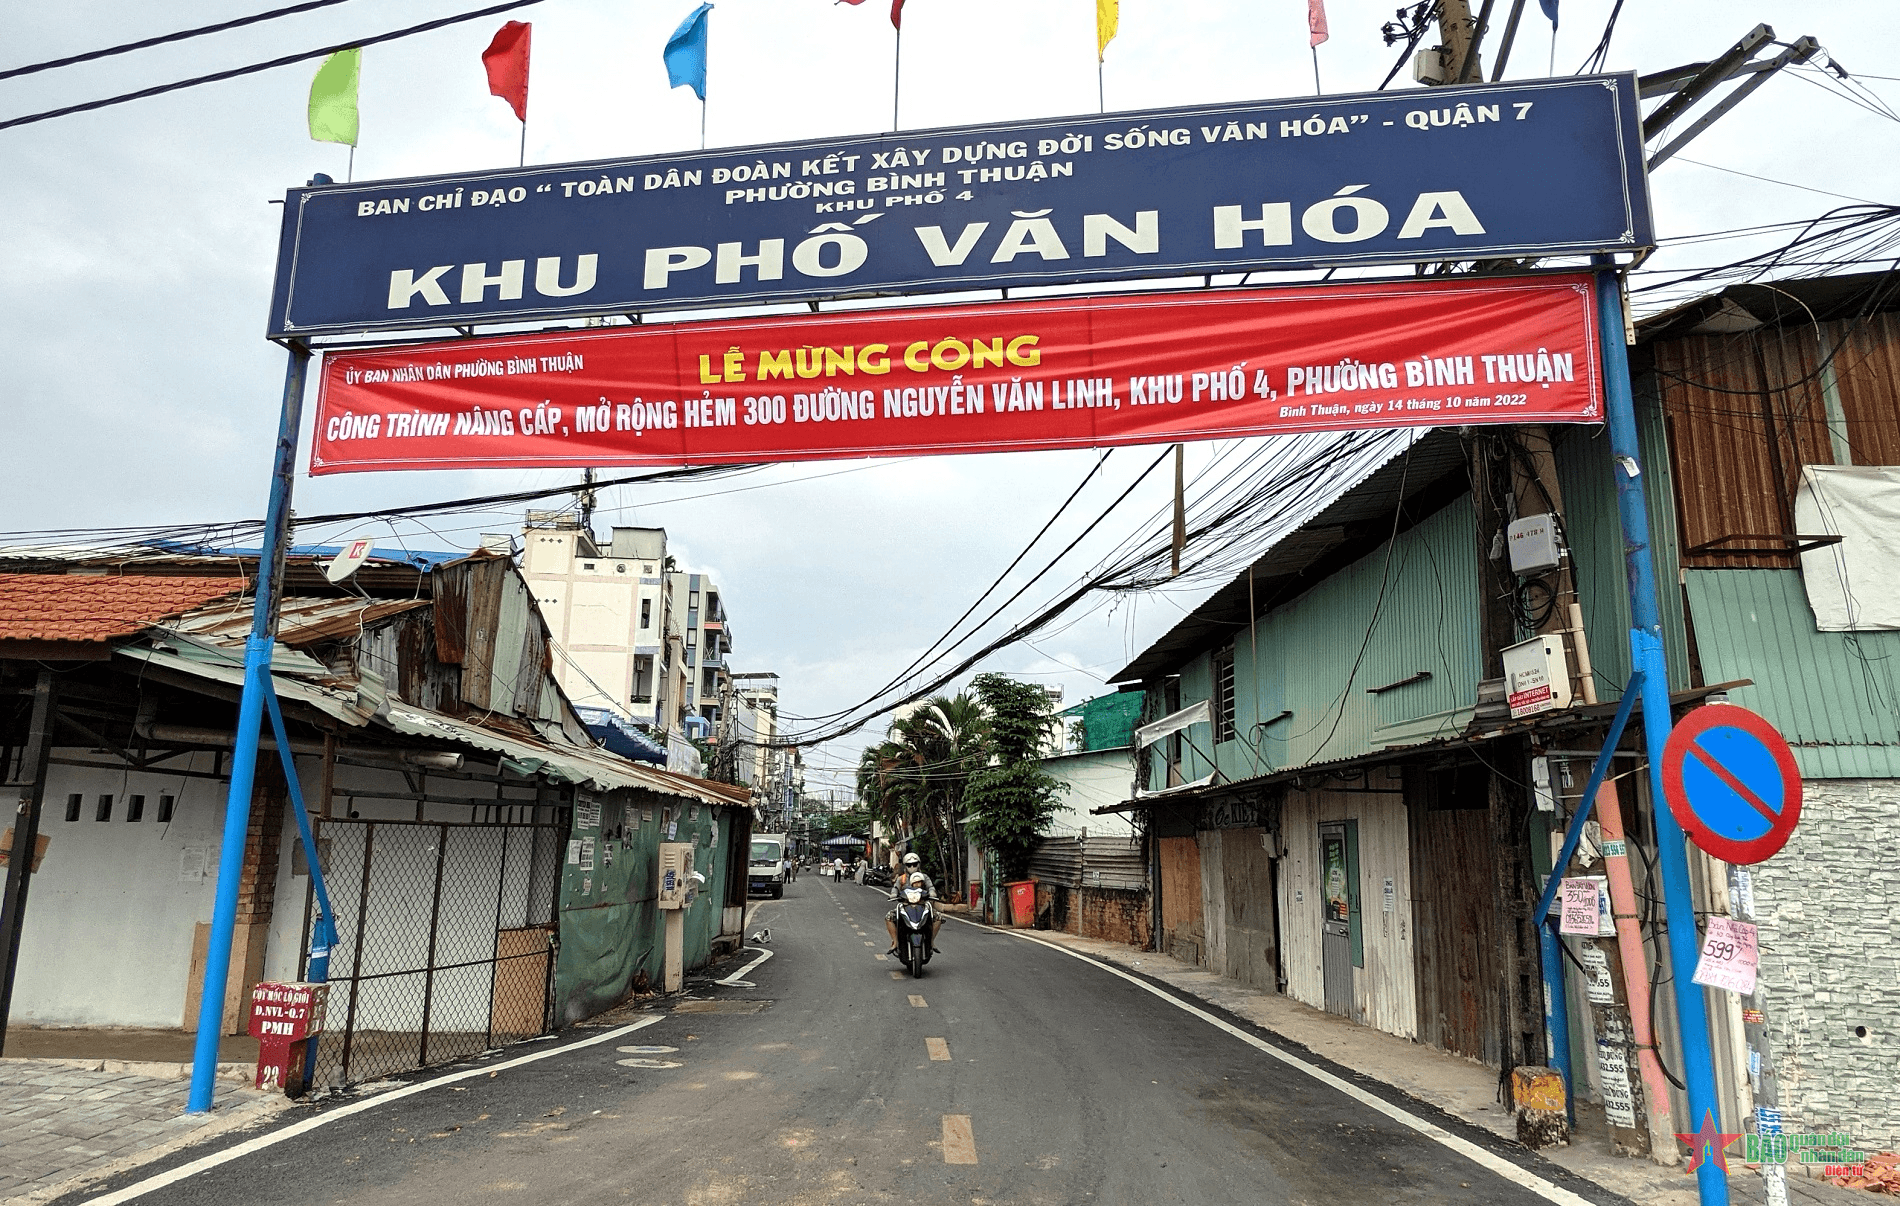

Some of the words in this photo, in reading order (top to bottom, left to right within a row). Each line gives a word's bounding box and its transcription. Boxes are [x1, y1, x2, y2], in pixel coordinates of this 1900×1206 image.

[358, 198, 410, 216] BAN
[419, 188, 464, 211] CHỈ
[471, 187, 526, 207] ĐẠO
[561, 176, 634, 197] TOÀN
[644, 169, 702, 190] DÂN
[712, 160, 791, 184] ĐOÀN
[802, 146, 860, 176] KẾT
[871, 147, 931, 169] XÂY
[943, 141, 1027, 164] DỰNG
[1038, 133, 1092, 155] ĐỜI
[1104, 125, 1190, 150] SỐNG
[1201, 121, 1267, 142] VĂN
[1280, 114, 1368, 137] HÓA”
[1406, 103, 1499, 130] QUẬN
[1513, 102, 1533, 120] 7
[726, 180, 855, 204] PHƯỜNG
[882, 172, 947, 194] BÌNH
[958, 161, 1072, 184] THUẬN
[816, 199, 874, 213] KHU
[886, 189, 947, 207] PHỐ
[956, 191, 974, 200] 4
[387, 253, 599, 310] KHU
[644, 213, 885, 289] PHỐ
[914, 209, 1159, 266] VĂN
[1214, 184, 1486, 250] HÓA
[347, 371, 362, 384] ỦY
[365, 370, 389, 383] BAN
[392, 364, 424, 381] NHÂN
[427, 362, 451, 380] DÂN
[455, 360, 503, 378] PHƯỜNG
[507, 356, 536, 374] BÌNH
[540, 352, 583, 372] THUẬN
[700, 347, 746, 384] LỄ
[757, 344, 890, 380] MỪNG
[903, 335, 1041, 372] CÔNG
[327, 412, 380, 441] CÔNG
[387, 410, 450, 437] TRÌNH
[453, 406, 514, 436] NÂNG
[520, 400, 568, 436] CẤP,
[576, 397, 611, 432] MỞ
[617, 398, 677, 436] RỘNG
[685, 391, 735, 427] HẺM
[744, 396, 786, 424] 300
[793, 387, 874, 422] ĐƯỜNG
[884, 375, 983, 417] NGUYỄN
[992, 377, 1043, 412] VĂN
[1053, 378, 1120, 410] LINH,
[1131, 375, 1182, 405] KHU
[1192, 362, 1247, 401] PHỐ
[1254, 370, 1276, 401] 4,
[1288, 358, 1397, 396] PHƯỜNG
[1405, 355, 1474, 387] BÌNH
[1481, 348, 1574, 383] THUẬN
[1280, 406, 1306, 417] Bình
[1311, 404, 1350, 416] Thuận,
[1355, 401, 1383, 414] ngày
[1388, 400, 1403, 410] 14
[1407, 398, 1441, 410] tháng
[1446, 397, 1461, 407] 10
[1465, 397, 1490, 406] năm
[1494, 394, 1526, 405] 2022
[1523, 686, 1549, 699] INTERNET
[261, 1021, 295, 1036] PMH
